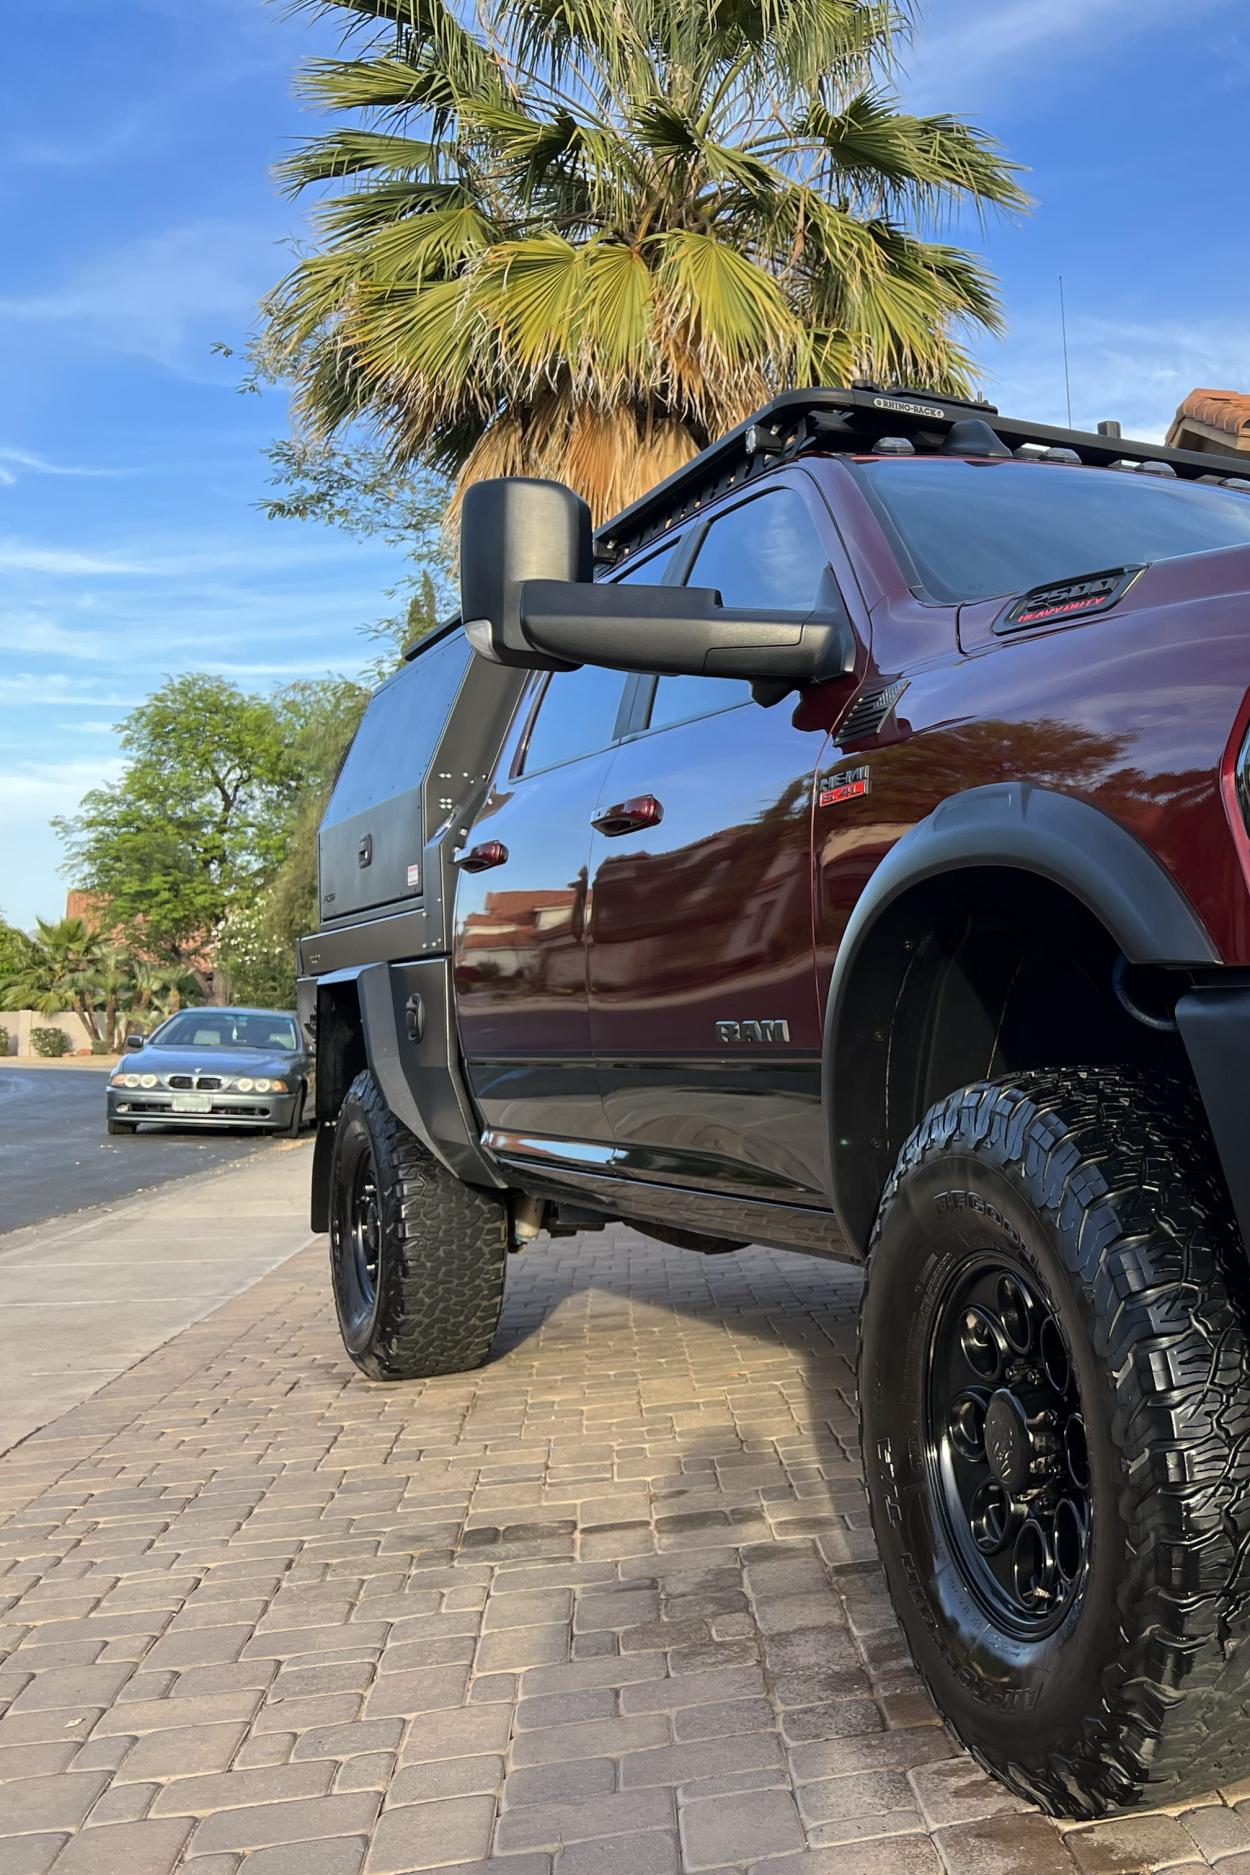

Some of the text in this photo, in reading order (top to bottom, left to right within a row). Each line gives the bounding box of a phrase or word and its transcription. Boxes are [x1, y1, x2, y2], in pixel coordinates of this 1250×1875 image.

[882, 400, 937, 416] RHINO-RACK
[1026, 578, 1117, 608] 2500
[1018, 605, 1065, 622] HEAVY
[820, 765, 870, 791] HEMI
[714, 1020, 790, 1042] RAM
